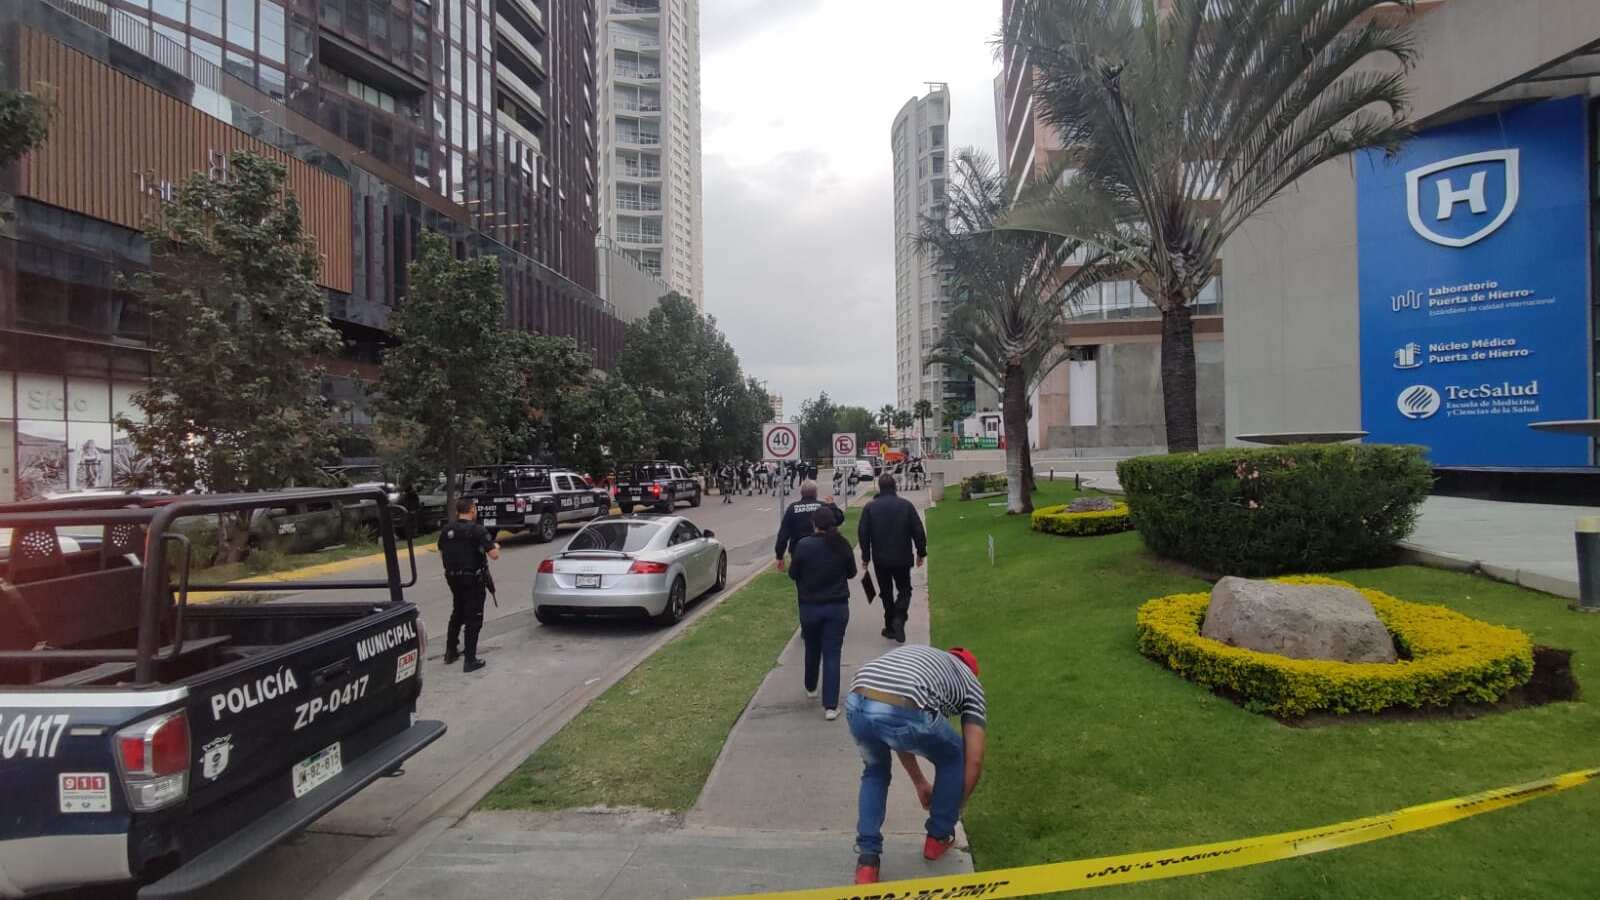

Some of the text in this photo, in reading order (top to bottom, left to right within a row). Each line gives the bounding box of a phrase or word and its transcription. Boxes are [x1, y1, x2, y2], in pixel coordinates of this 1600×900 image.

[1429, 280, 1498, 297] Laboratorio
[1429, 296, 1468, 308] Puerta
[1471, 294, 1486, 303] de
[1429, 337, 1516, 353] Núcleo Médico
[1429, 353, 1468, 364] Puerta
[1471, 351, 1486, 361] de
[1445, 379, 1539, 400] TecSalud
[1446, 398, 1535, 410] Escuela de Medicina
[1452, 408, 1489, 417] Ciencias
[1491, 407, 1502, 415] de
[1502, 406, 1511, 414] la
[1512, 405, 1539, 414] Salud
[773, 432, 790, 447] 40
[211, 621, 416, 721] POLICÍA MUNICIPAL
[294, 674, 369, 730] ZP-0417
[0, 713, 70, 759] -0417
[64, 777, 104, 790] 911
